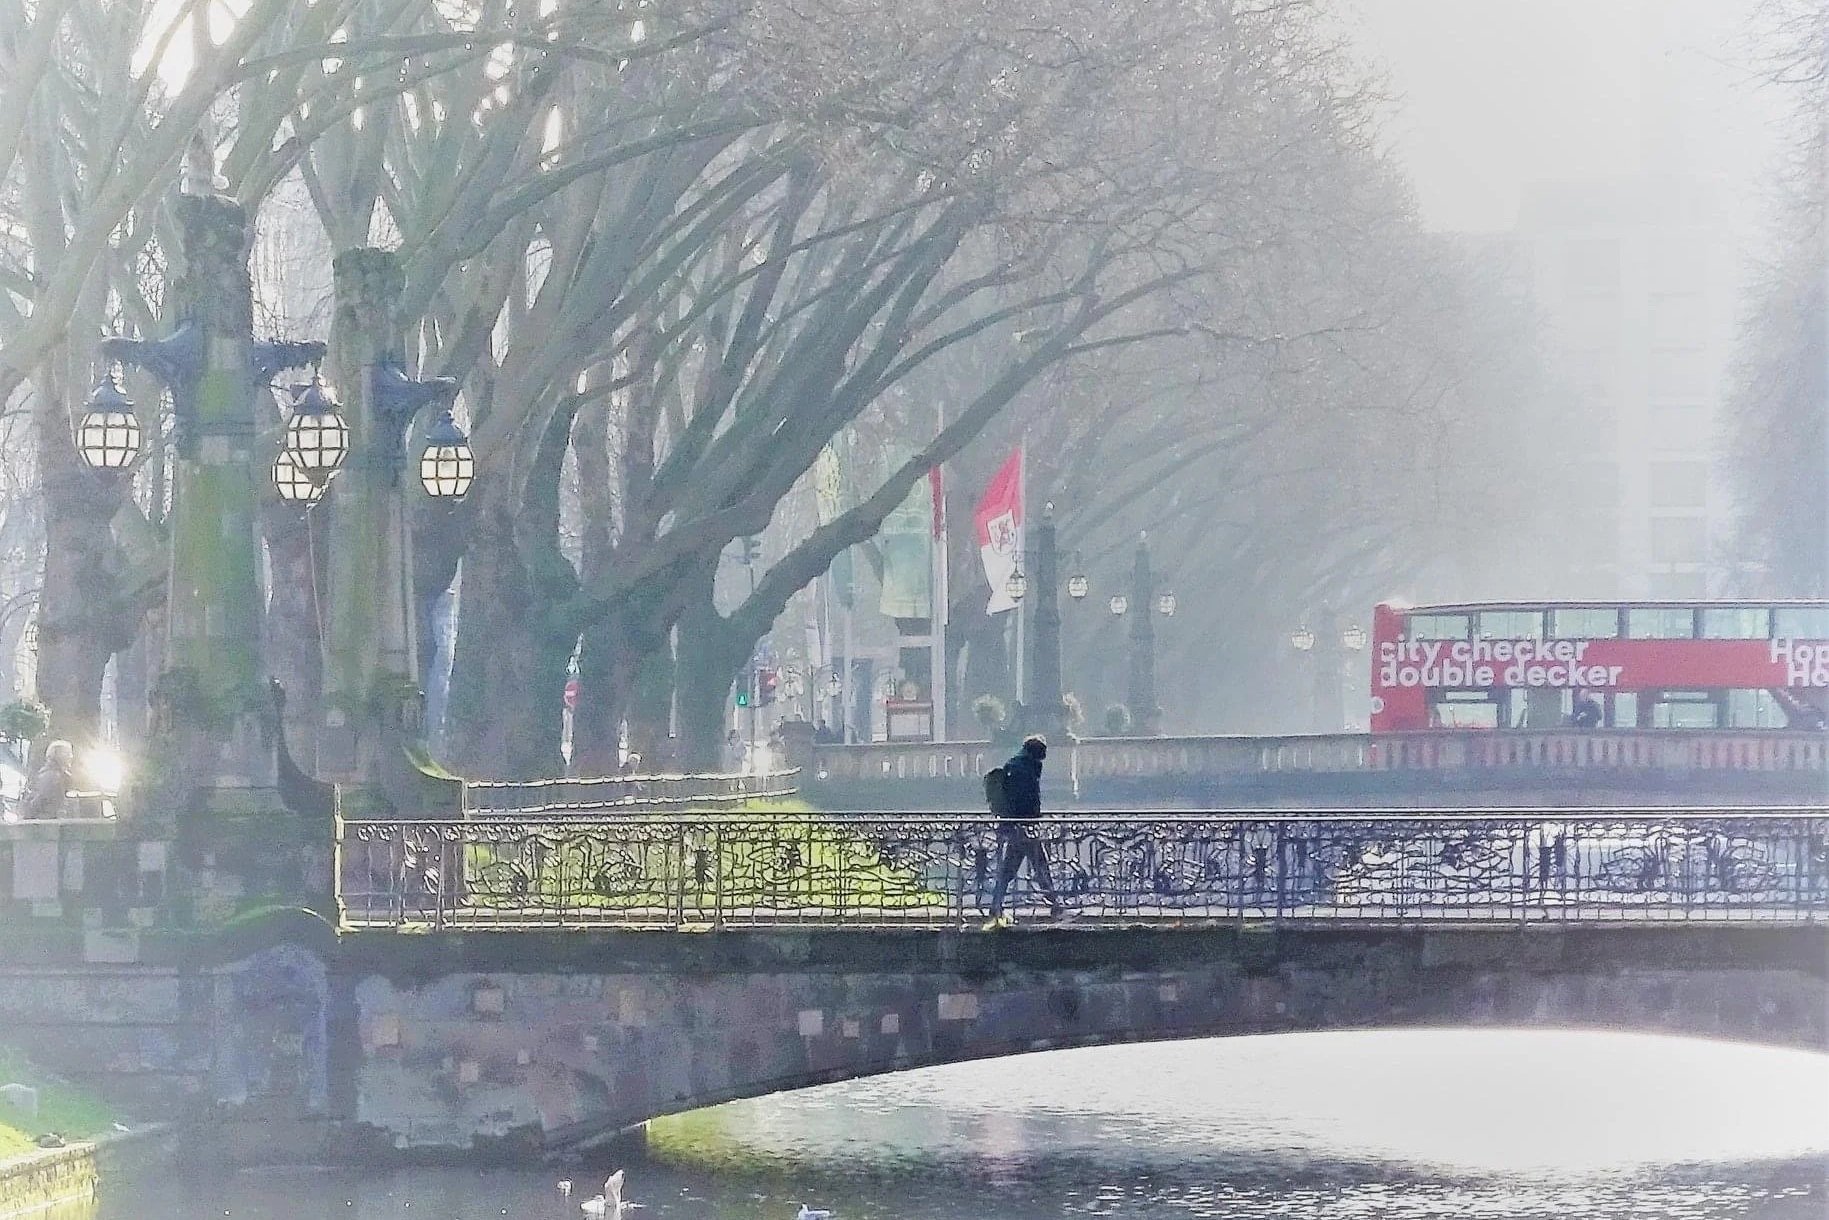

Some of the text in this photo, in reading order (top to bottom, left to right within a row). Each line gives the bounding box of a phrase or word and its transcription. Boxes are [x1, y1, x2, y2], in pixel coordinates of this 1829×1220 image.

[1381, 633, 1589, 668] city checker
[1381, 658, 1623, 687] double decker
